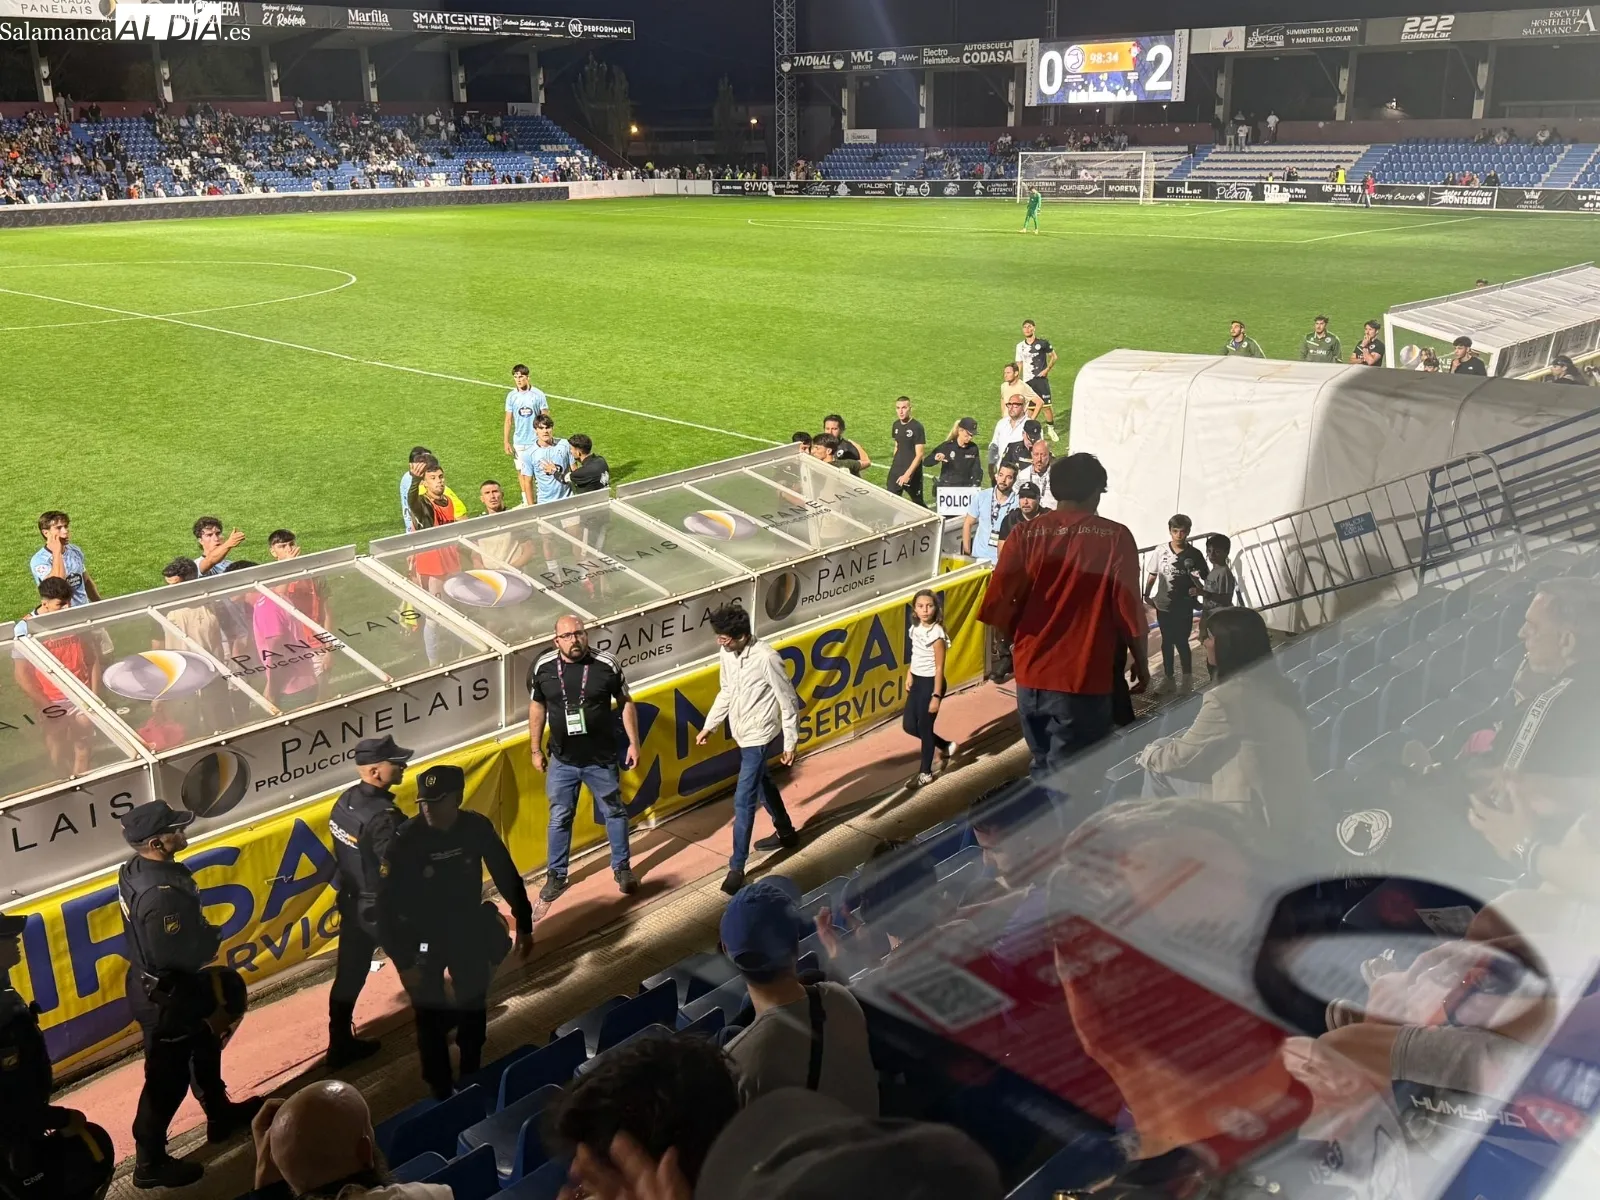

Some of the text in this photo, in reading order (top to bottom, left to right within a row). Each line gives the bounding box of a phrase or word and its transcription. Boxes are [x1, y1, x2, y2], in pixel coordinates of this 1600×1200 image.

[21, 4, 93, 14] PANELAIS
[348, 9, 389, 23] Marfila
[262, 12, 274, 25] El
[412, 12, 492, 27] SMARTCENTER
[1403, 15, 1455, 32] 222
[583, 25, 632, 34] PERFORMANCE
[1252, 28, 1259, 37] el
[1286, 28, 1325, 36] SUMINISTROS
[1334, 25, 1358, 33] OFICINA
[1401, 31, 1451, 40] GoldenCar
[963, 42, 1014, 51] AUTOESCUELA
[1295, 36, 1324, 44] MATERIAL
[1325, 35, 1351, 43] ESCOLAR
[923, 47, 948, 57] Electro
[962, 50, 1014, 64] CODASA
[1039, 50, 1062, 95] 0
[1090, 52, 1119, 65] 98:34
[1145, 44, 1172, 91] 2
[986, 185, 1013, 193] Carrasco
[1108, 184, 1138, 193] MORETA
[1166, 186, 1174, 194] El
[1442, 195, 1492, 206] MONTSERRAT
[760, 486, 870, 525] PANELAIS
[938, 494, 972, 508] POLICI
[539, 540, 679, 584] PANELAIS
[816, 535, 931, 595] PANELAIS
[800, 574, 875, 606] PRODUCCIONES
[230, 609, 421, 671] PANELAIS
[620, 643, 674, 669] CCIONES
[280, 677, 490, 773] PANELAIS
[254, 747, 357, 793] PRODUCCIO
[11, 791, 136, 853] LAIS
